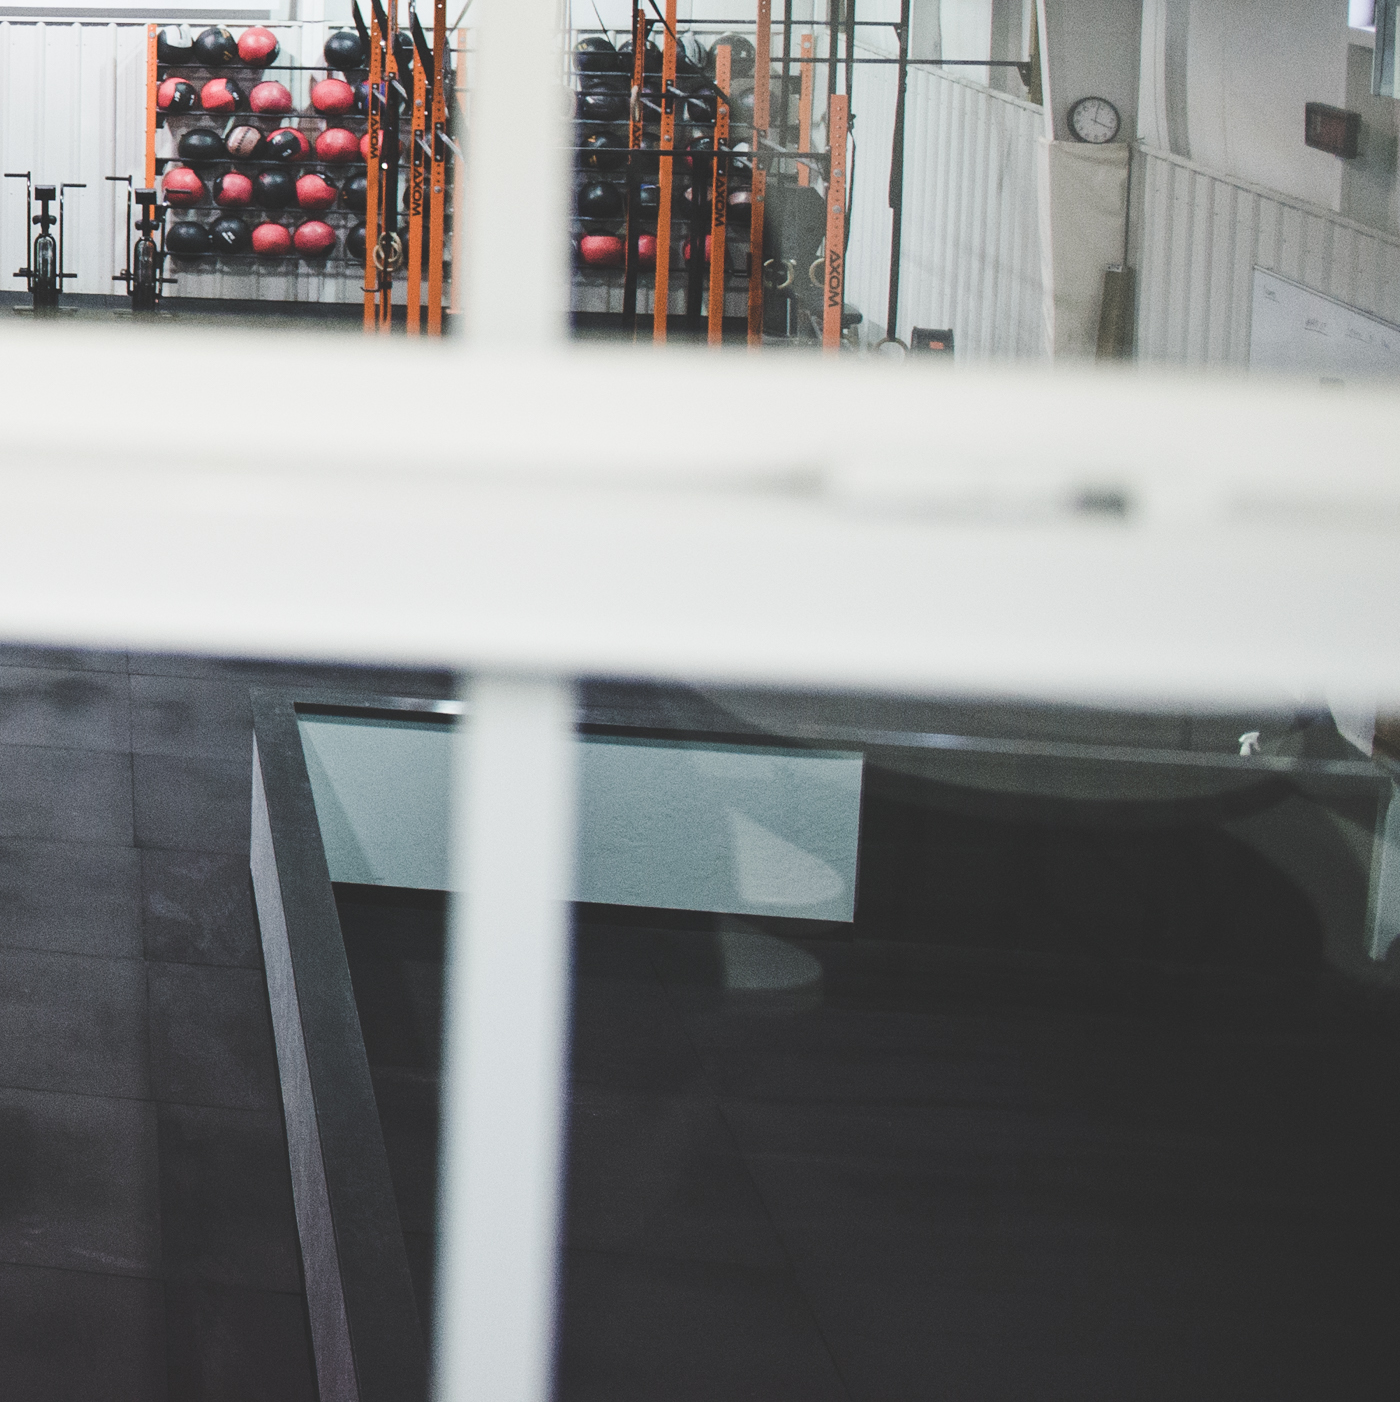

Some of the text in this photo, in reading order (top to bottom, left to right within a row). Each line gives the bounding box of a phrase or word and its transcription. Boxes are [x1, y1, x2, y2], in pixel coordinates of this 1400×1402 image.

[370, 117, 379, 159] AXOM
[412, 167, 423, 216] AXOM
[714, 178, 726, 227] AXOM
[828, 249, 841, 308] AXOM
